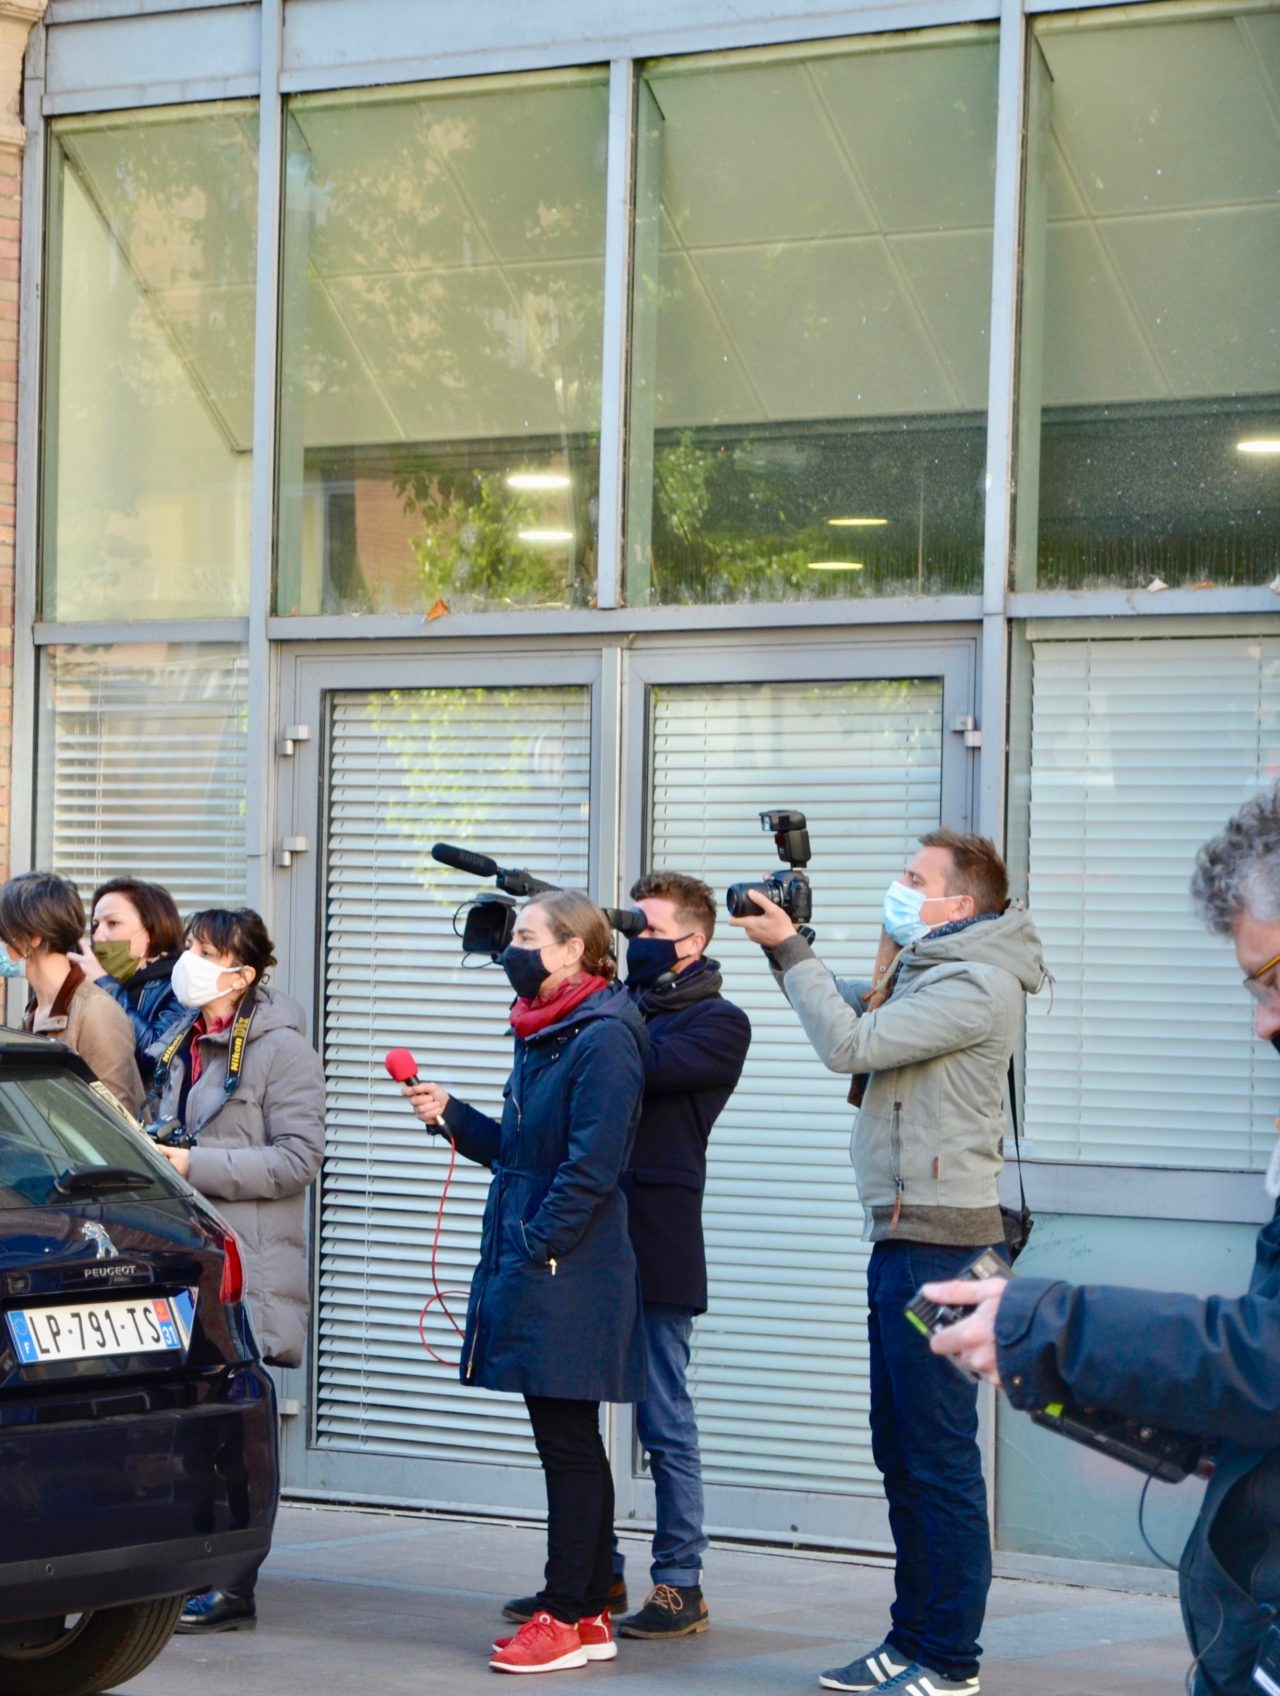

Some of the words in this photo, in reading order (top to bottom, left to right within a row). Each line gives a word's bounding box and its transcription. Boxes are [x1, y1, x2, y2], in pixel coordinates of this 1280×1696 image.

[230, 1037, 243, 1072] Nikon
[84, 1265, 136, 1279] PEUGEOT
[162, 1325, 178, 1345] 31
